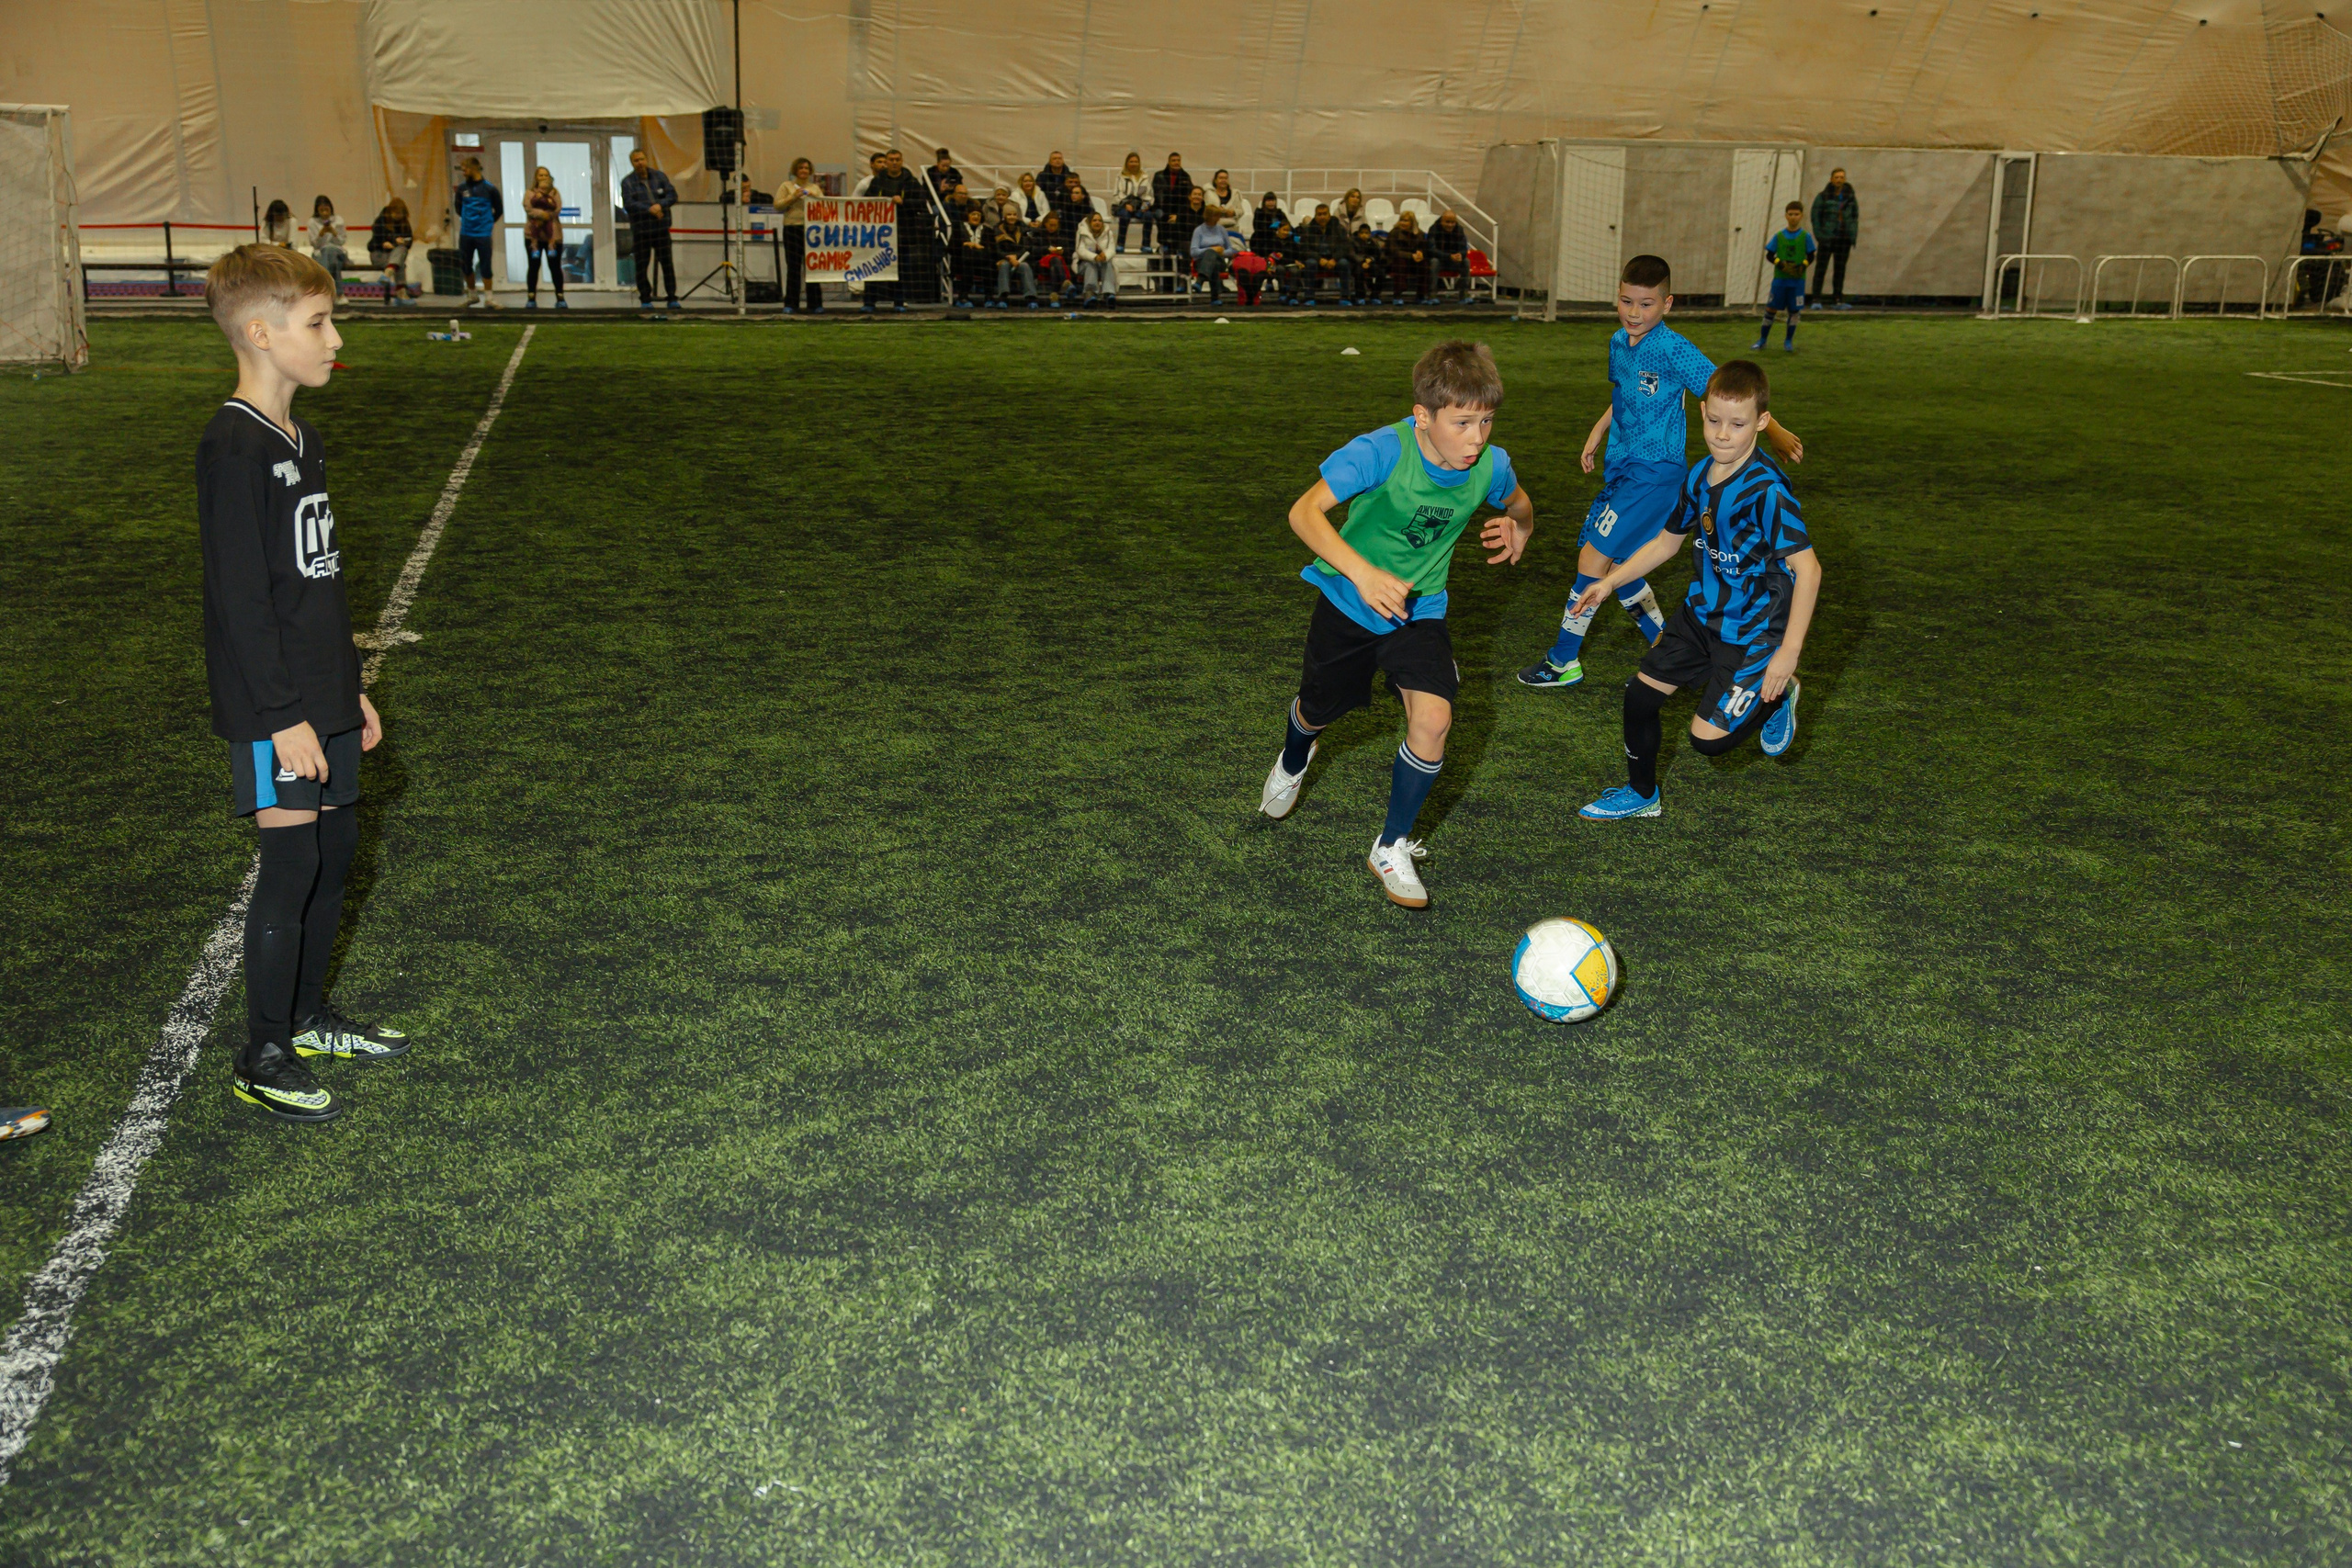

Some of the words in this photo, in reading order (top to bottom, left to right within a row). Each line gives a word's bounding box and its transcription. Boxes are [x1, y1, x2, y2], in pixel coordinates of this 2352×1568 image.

[807, 200, 839, 222] НАШИ
[844, 200, 895, 223] ПАРНИ
[1416, 504, 1454, 519] ДЖУНИОР
[1594, 502, 1619, 537] 18
[1724, 684, 1756, 717] 10
